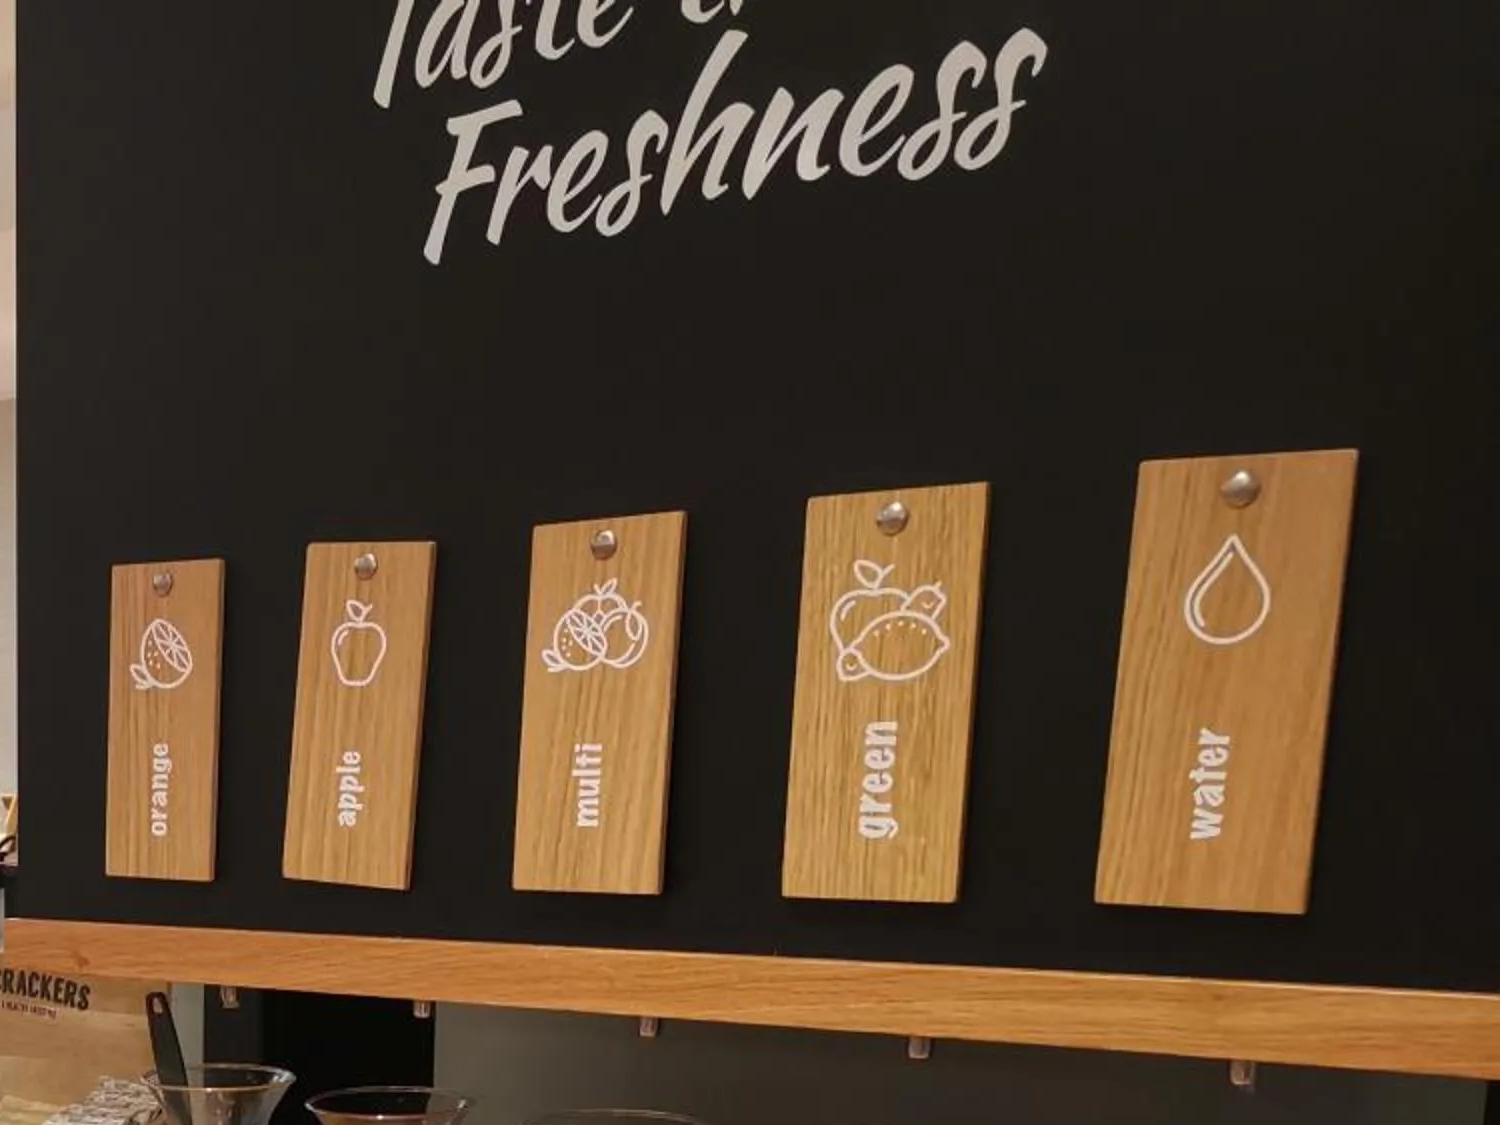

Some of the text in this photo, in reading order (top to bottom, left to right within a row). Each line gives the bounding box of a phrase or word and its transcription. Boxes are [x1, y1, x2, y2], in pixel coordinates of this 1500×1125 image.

[422, 26, 1048, 265] Freshness
[151, 743, 169, 837] orange
[336, 749, 362, 828] apple
[572, 743, 603, 828] multi
[858, 720, 899, 840] green
[1189, 727, 1231, 840] water
